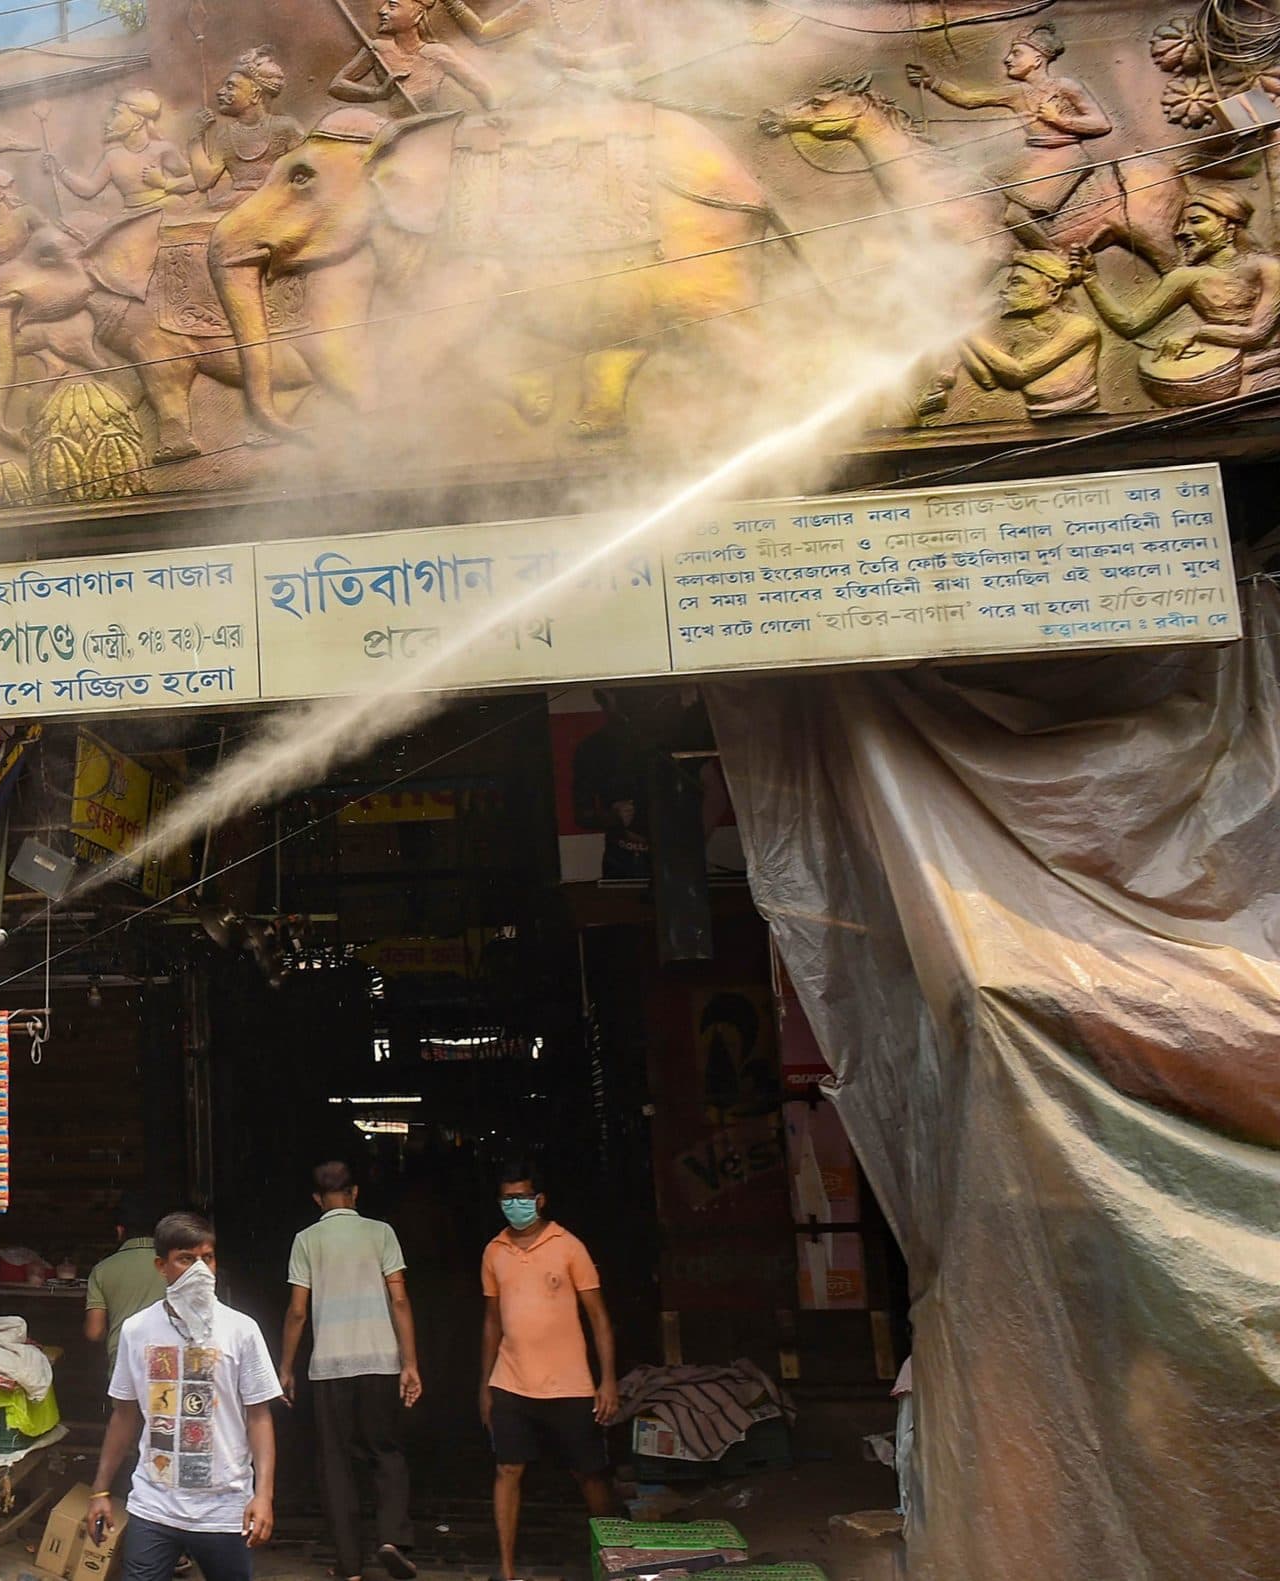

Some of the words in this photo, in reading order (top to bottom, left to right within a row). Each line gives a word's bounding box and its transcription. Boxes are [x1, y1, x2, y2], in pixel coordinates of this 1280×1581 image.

[734, 517, 776, 533] সালে
[868, 507, 911, 522] নবাব
[1125, 487, 1160, 502] আর
[1177, 481, 1210, 498] তাঁর
[675, 544, 747, 565] সেনাপতি
[756, 538, 844, 559] মীর-মদন
[858, 538, 871, 550] ও
[1000, 523, 1052, 542] বিশাল
[1066, 513, 1160, 537] সৈন্যবাহিনী
[1172, 509, 1213, 528] নিয়ে
[143, 562, 234, 588] বাজার
[264, 552, 494, 620] হাতিবাগান
[675, 570, 755, 588] কলকাতায়
[760, 563, 851, 583] ইংরেজদের
[857, 556, 899, 575] তৈরি
[908, 552, 947, 572] ফোর্ট
[952, 548, 1030, 569] উইলিয়াম
[1036, 543, 1063, 567] দুর্গ
[1068, 543, 1135, 559] আক্রমণ
[678, 597, 699, 610] সে
[710, 593, 747, 607] সময়
[758, 588, 823, 605] নবাবের
[833, 577, 921, 599] হস্তিবাহিনী
[934, 577, 970, 592] রাখা
[981, 570, 1050, 589] হয়েছিল
[1063, 567, 1089, 582] এই
[1182, 559, 1220, 579] মুখে
[678, 624, 714, 643] মুখে
[720, 620, 753, 637] রটে
[760, 618, 810, 634] গেলো
[979, 604, 1016, 619] পরে
[1022, 603, 1040, 617] যা
[1048, 599, 1089, 615] হলো
[1154, 612, 1198, 630] রবীন
[1208, 612, 1228, 626] দে
[52, 668, 152, 702] সজ্জিত
[162, 664, 237, 695] হলো
